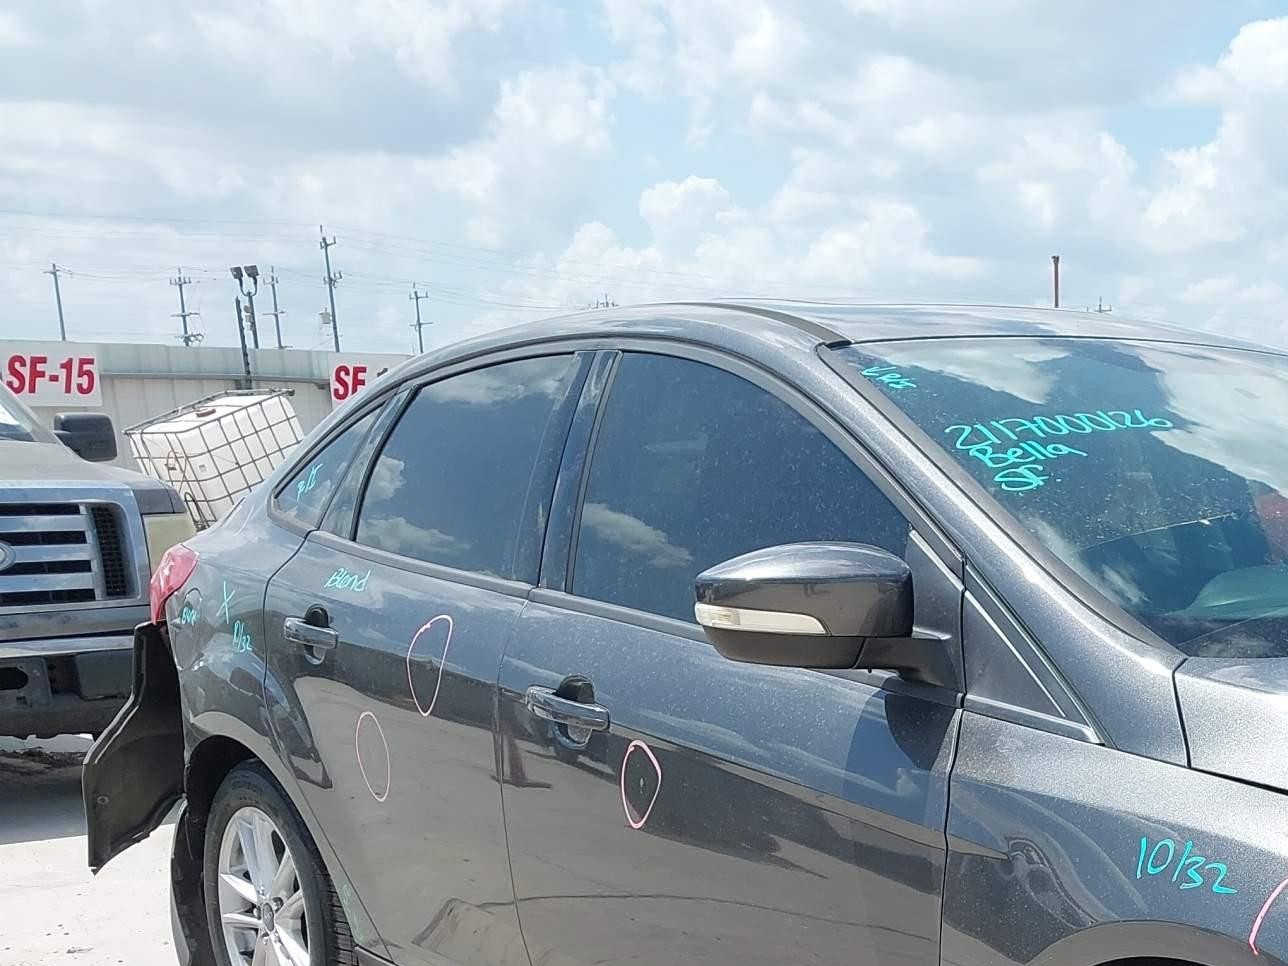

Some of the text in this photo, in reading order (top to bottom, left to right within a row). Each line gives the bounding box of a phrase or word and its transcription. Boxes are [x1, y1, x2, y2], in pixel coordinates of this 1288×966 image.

[6, 355, 95, 394] SF-15
[333, 365, 388, 400] SF
[968, 441, 1088, 468] Bella
[1136, 836, 1238, 894] 10/32
